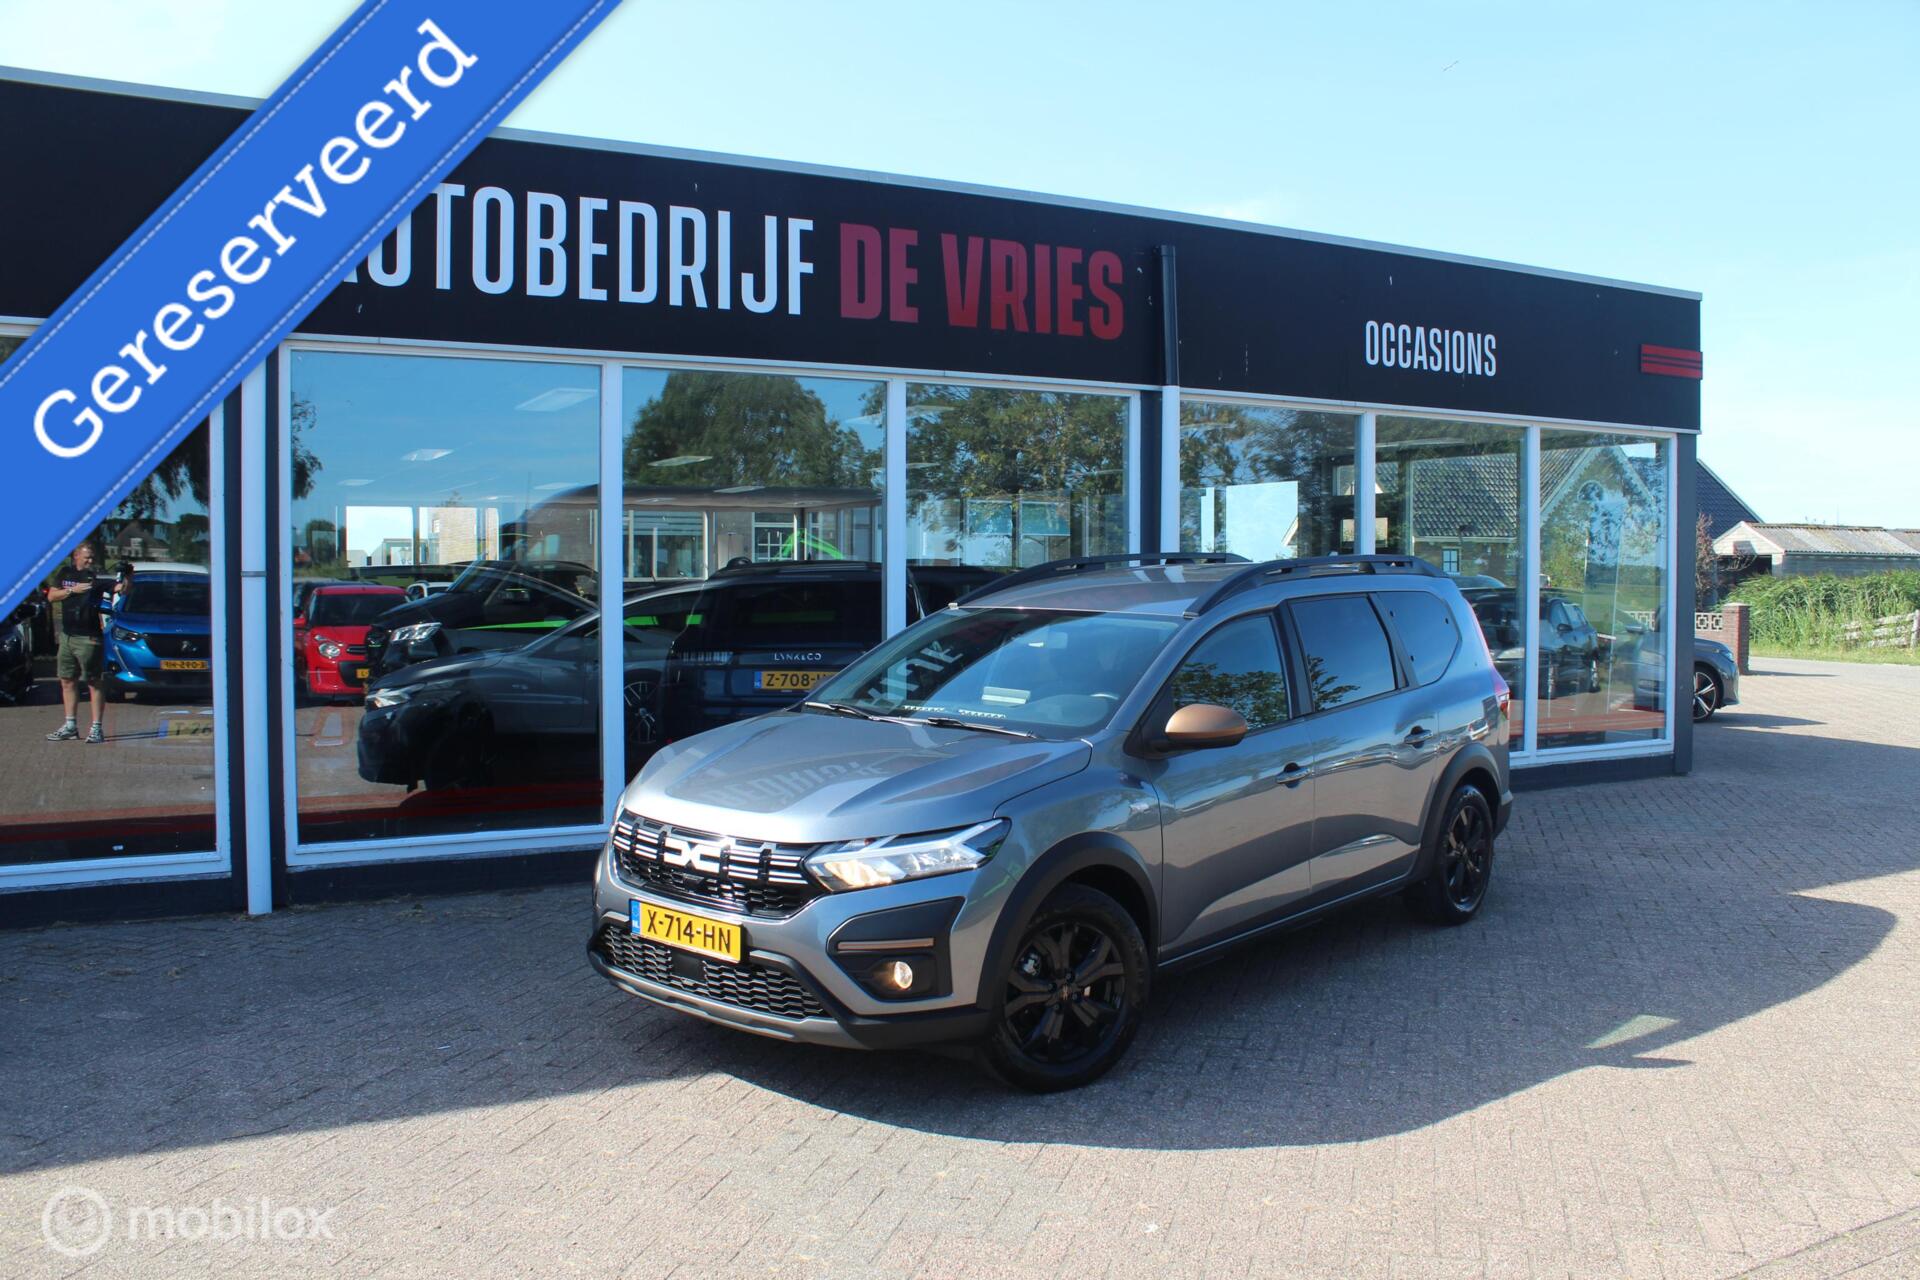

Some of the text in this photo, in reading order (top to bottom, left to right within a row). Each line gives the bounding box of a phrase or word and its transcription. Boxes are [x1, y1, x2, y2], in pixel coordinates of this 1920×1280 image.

[344, 183, 1124, 340] UTOBEDRIJF DE VRIES
[1365, 320, 1497, 377] OCCASIONS
[647, 909, 731, 954] X-714-HN
